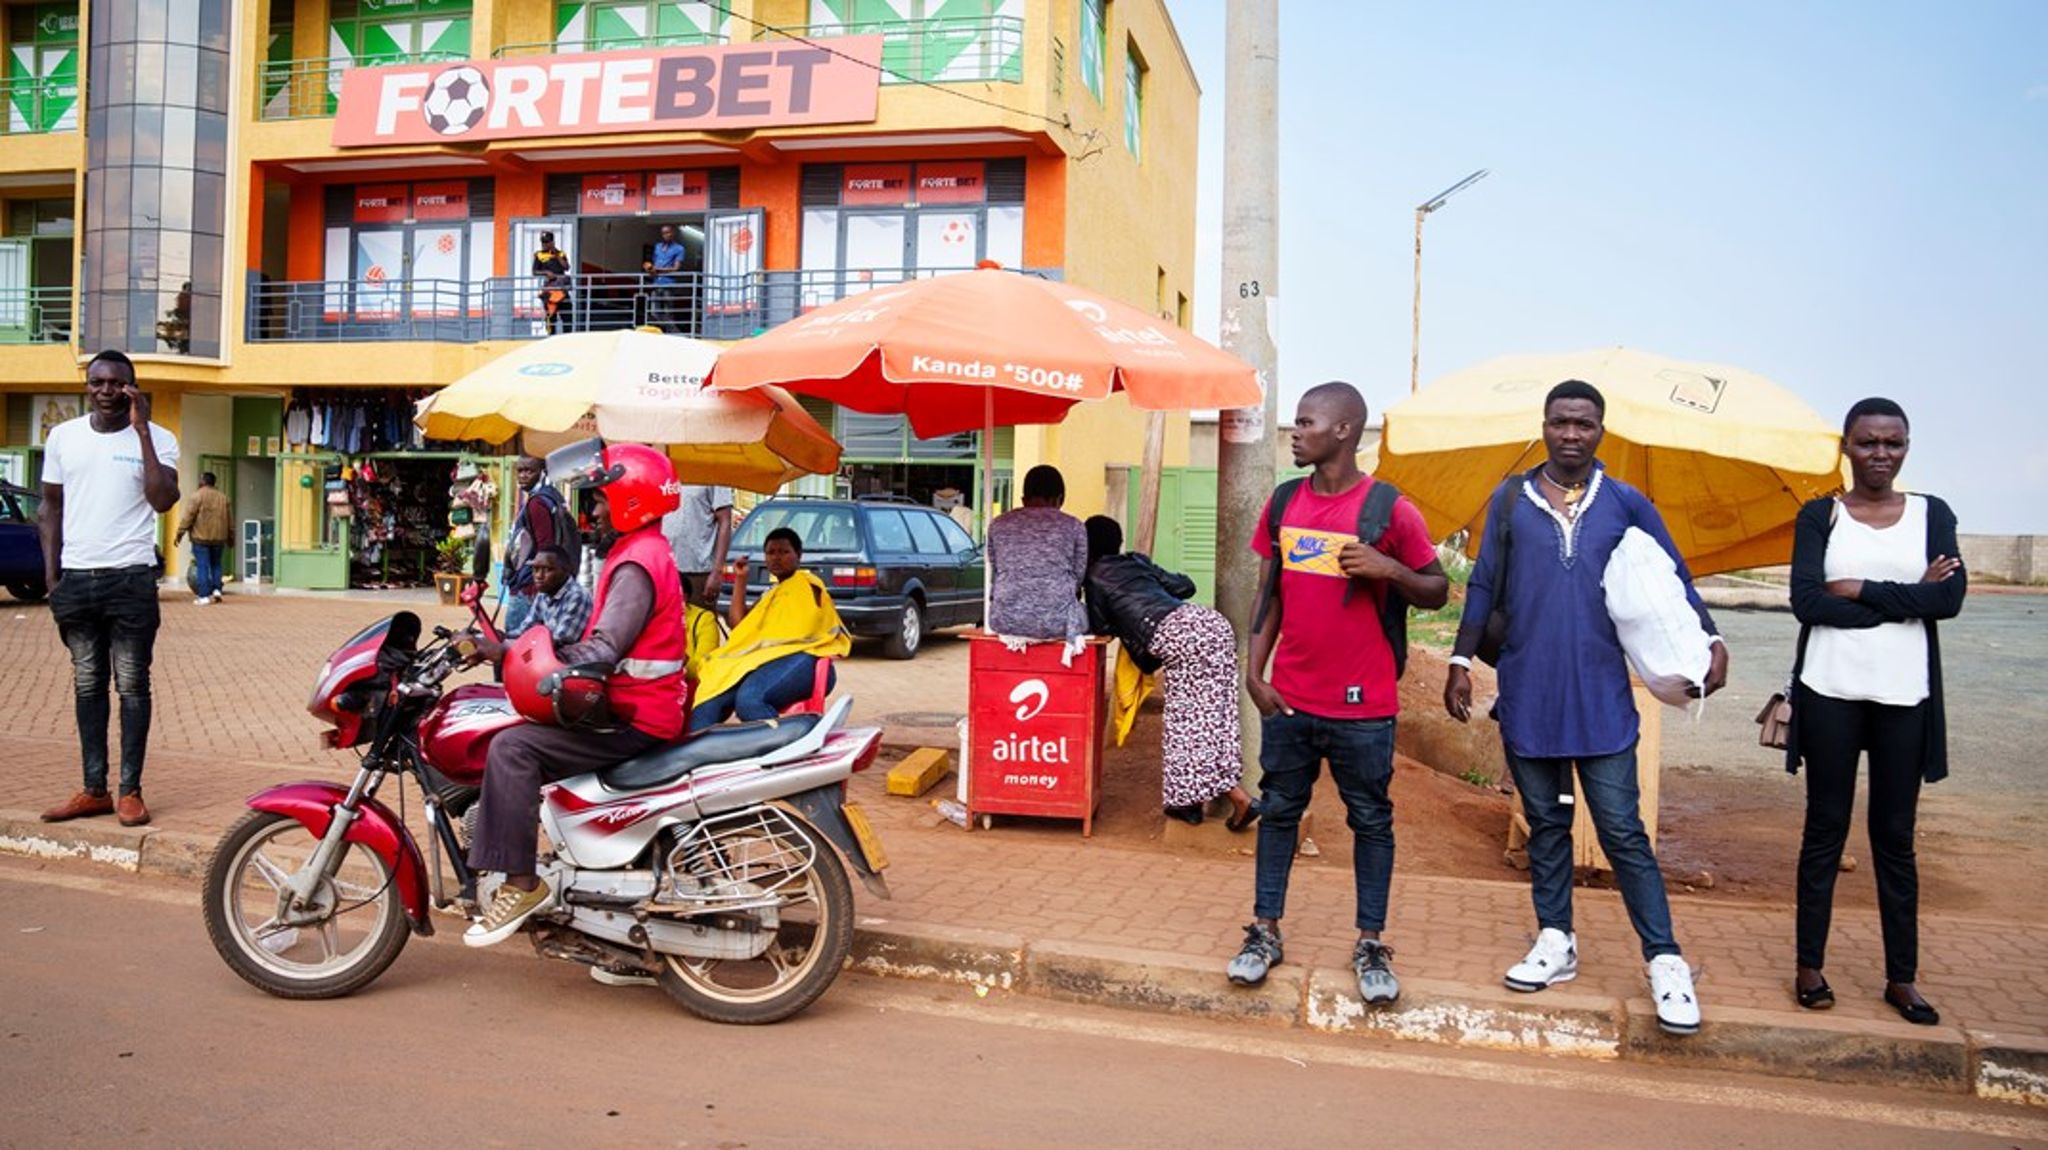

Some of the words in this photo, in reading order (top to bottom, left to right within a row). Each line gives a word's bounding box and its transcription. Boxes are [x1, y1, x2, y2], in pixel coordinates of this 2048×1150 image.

[375, 49, 832, 137] FORTEBET
[1239, 280, 1260, 299] 63
[912, 355, 996, 379] Kanda
[1296, 535, 1329, 552] NIKE
[992, 732, 1070, 764] airtel
[1004, 773, 1058, 790] money
